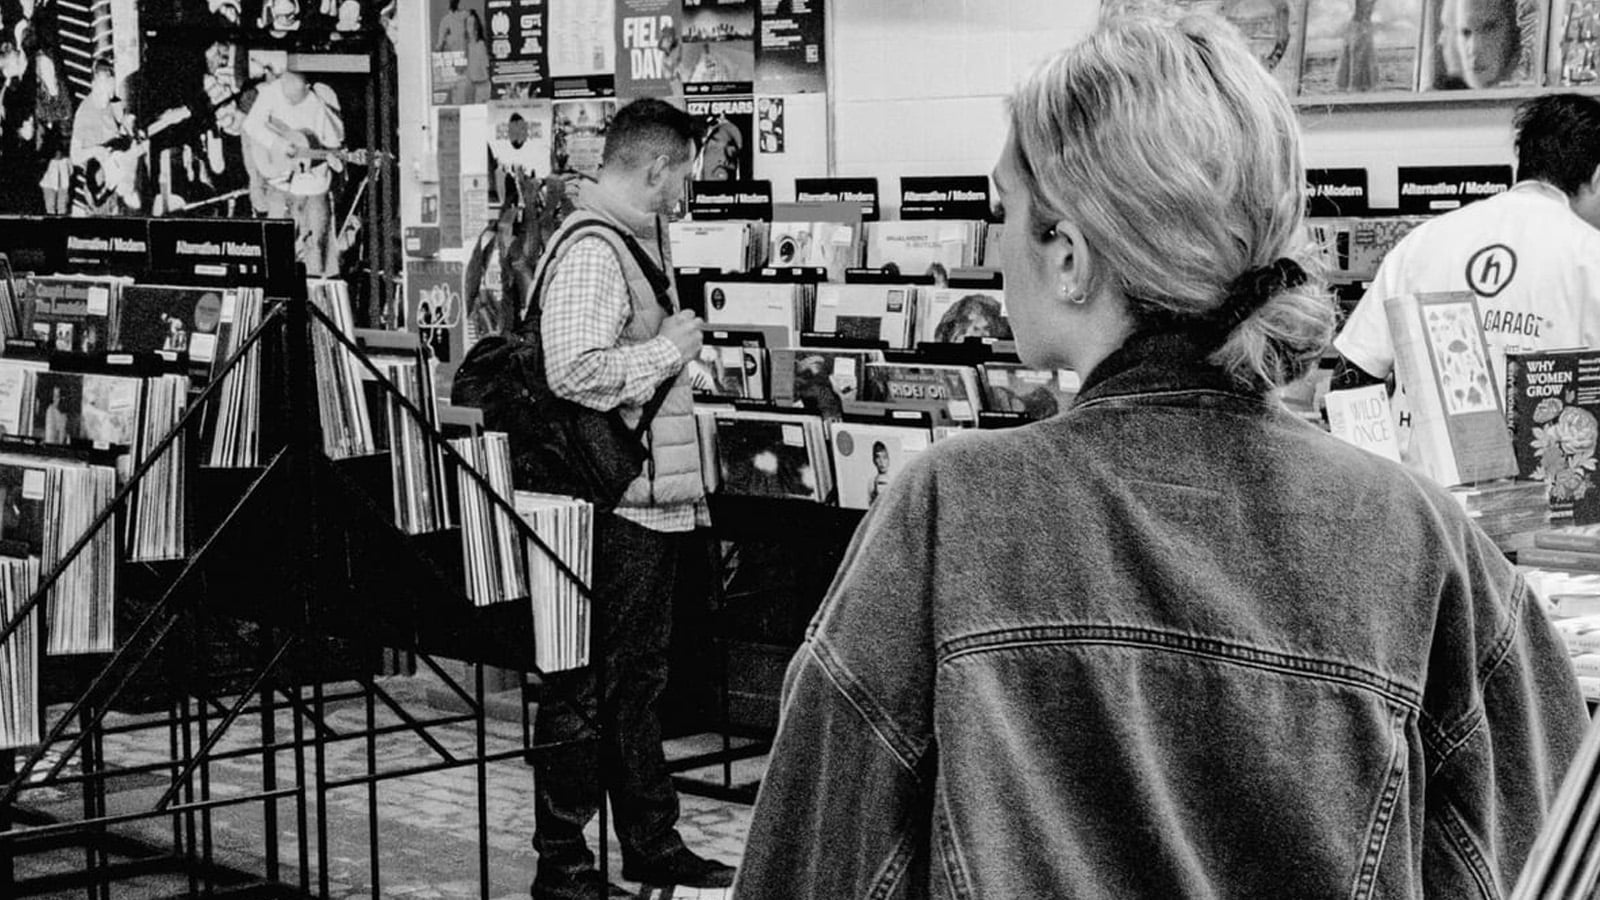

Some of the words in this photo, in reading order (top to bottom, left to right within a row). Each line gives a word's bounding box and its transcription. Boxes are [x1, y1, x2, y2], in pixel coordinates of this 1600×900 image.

[630, 48, 663, 80] DAY
[1323, 184, 1363, 196] Modern
[1401, 182, 1458, 195] Alternative
[1465, 181, 1508, 194] Modern
[696, 193, 734, 204] Alternative
[739, 193, 769, 204] Modern
[798, 192, 838, 202] Alternative
[843, 192, 875, 202] Modern
[904, 190, 947, 201] Alternative
[952, 190, 986, 201] Modern
[67, 235, 108, 251] Alternative
[113, 237, 147, 253] Modern
[176, 240, 221, 255] Alternative
[226, 241, 262, 257] Modern
[1526, 360, 1556, 373] WHY
[1526, 371, 1573, 385] WOMEN
[1526, 384, 1563, 397] GROW
[1350, 398, 1381, 420] WILD
